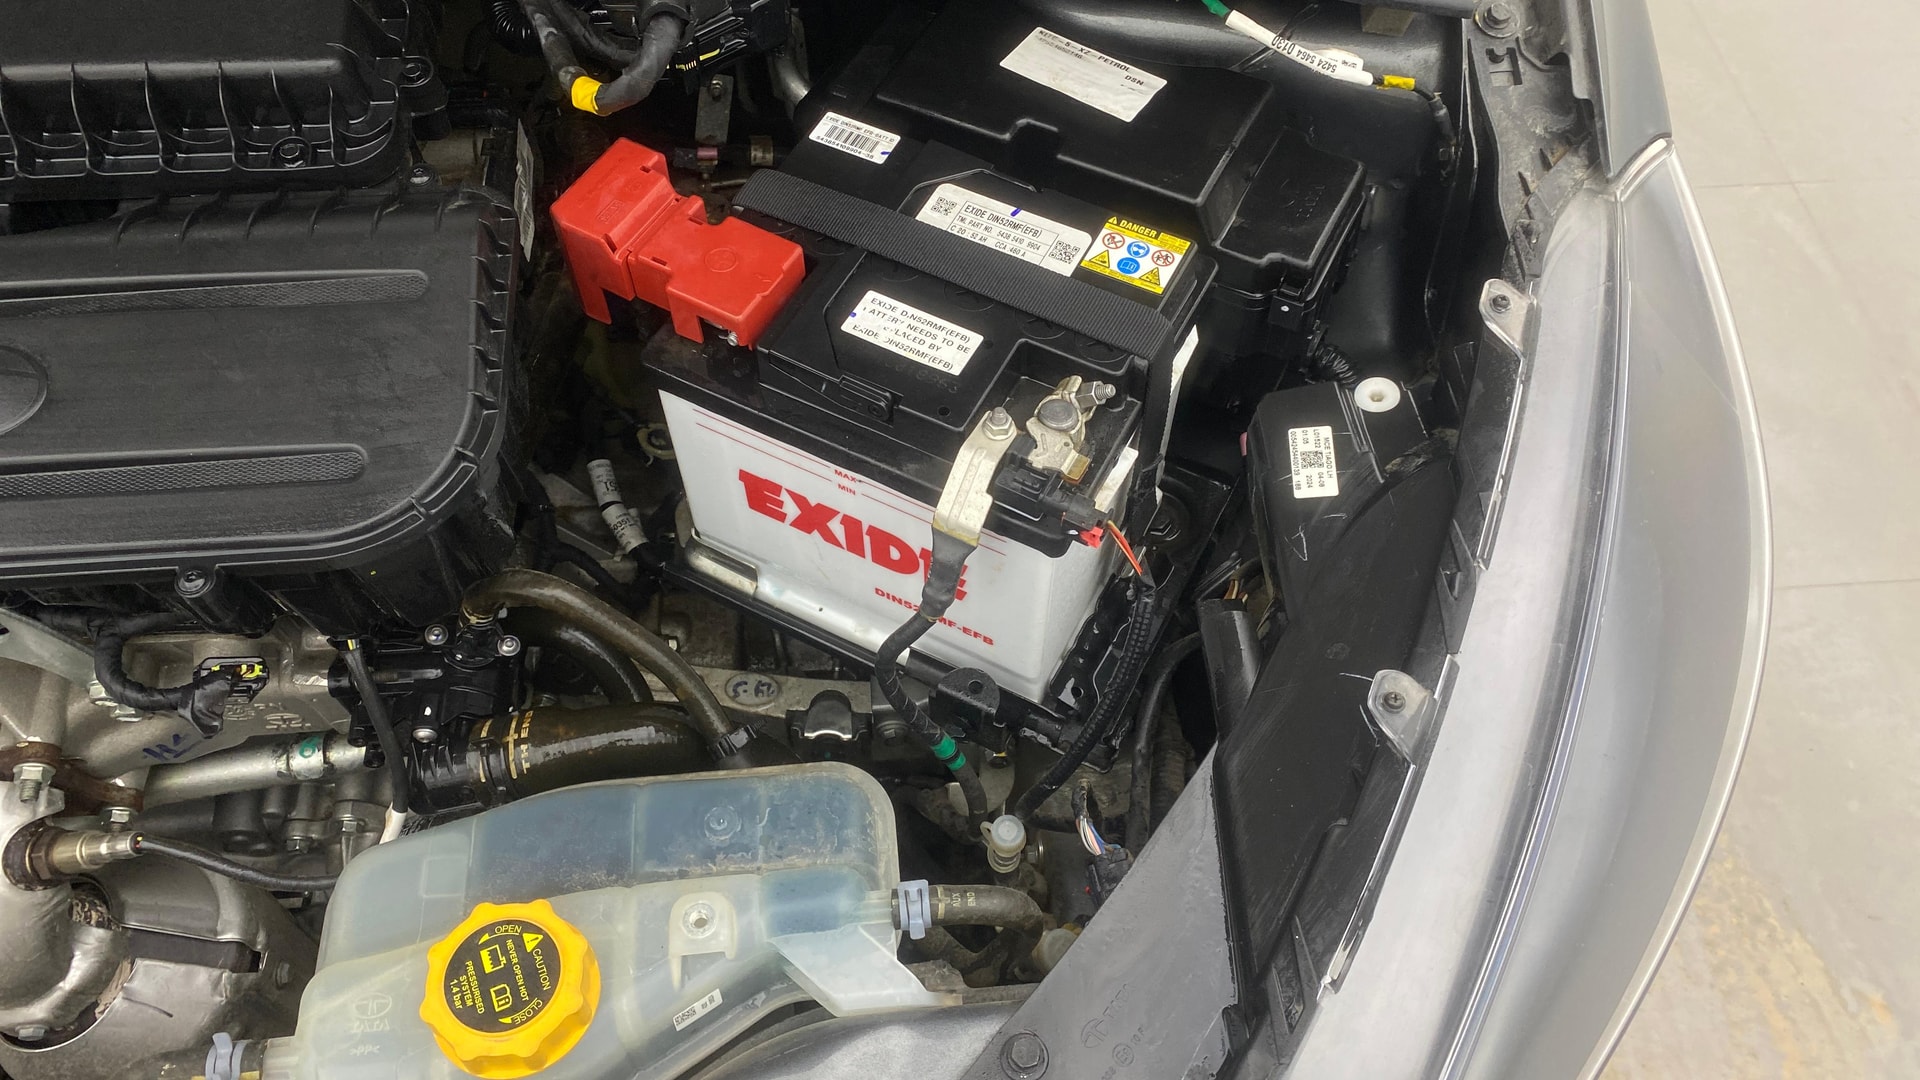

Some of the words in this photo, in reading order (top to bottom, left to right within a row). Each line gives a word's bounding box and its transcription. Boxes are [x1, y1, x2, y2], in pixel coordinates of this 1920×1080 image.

[1271, 35, 1295, 55] 0130
[1296, 49, 1316, 65] 5464
[1316, 58, 1337, 73] 5424
[1124, 74, 1144, 86] DSN
[957, 215, 968, 223] TML
[967, 219, 983, 230] PART
[983, 225, 993, 234] NO.
[964, 204, 987, 219] EXIDE
[986, 212, 1043, 239] DIN52RMF(EFB)
[1119, 219, 1158, 239] DANGER
[957, 227, 967, 235] 20
[971, 232, 979, 240] 52
[978, 235, 988, 243] AH
[994, 241, 1008, 251] CCA
[870, 297, 899, 313] EXIDE
[906, 323, 939, 341] NEEDS
[941, 337, 955, 347] TO
[956, 343, 972, 354] BE
[927, 342, 943, 353] BY
[834, 469, 857, 483] MAX
[1326, 470, 1334, 479] LH
[837, 483, 856, 496] MIN
[874, 587, 994, 646] DIN52MF-EFB
[520, 709, 534, 739] END
[951, 892, 961, 908] AUX
[966, 891, 977, 907] END
[494, 924, 522, 934] OPEN
[505, 938, 519, 965] NEVER
[512, 964, 525, 986] OPEN
[532, 948, 552, 991] CAUTION
[449, 979, 461, 993] 1.4
[459, 974, 474, 1006] SYSTEM
[465, 960, 485, 1014] PRESSURISED
[518, 986, 529, 1001] HOT
[453, 993, 463, 1009] bar
[512, 999, 543, 1025] CLOSE
